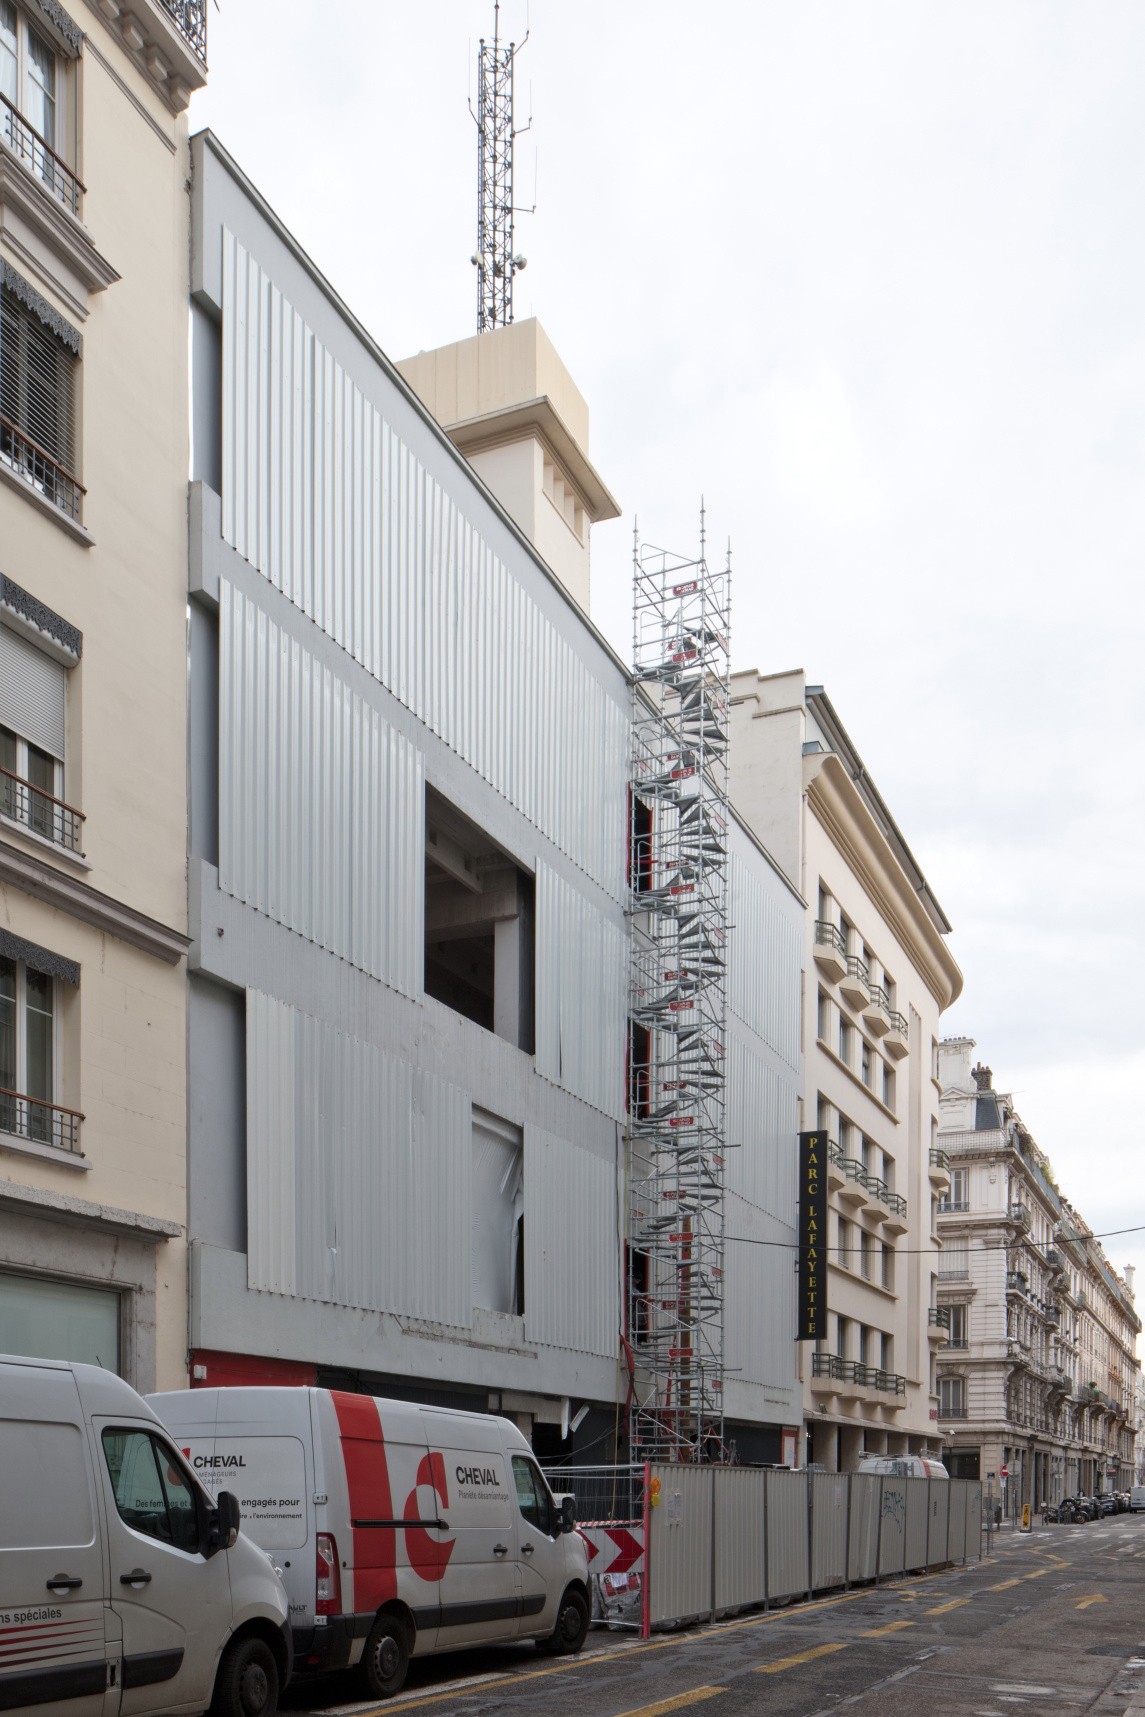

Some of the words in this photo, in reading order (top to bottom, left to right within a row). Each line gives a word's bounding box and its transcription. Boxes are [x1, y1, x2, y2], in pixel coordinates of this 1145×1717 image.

[808, 1137, 818, 1195] PARC
[807, 1206, 818, 1333] LAFAYETTE
[193, 1455, 246, 1468] CHEVAL
[456, 1466, 500, 1486] CHEVAL
[241, 1498, 277, 1507] engagés
[279, 1499, 300, 1507] pour
[14, 1608, 62, 1624] spéciales
